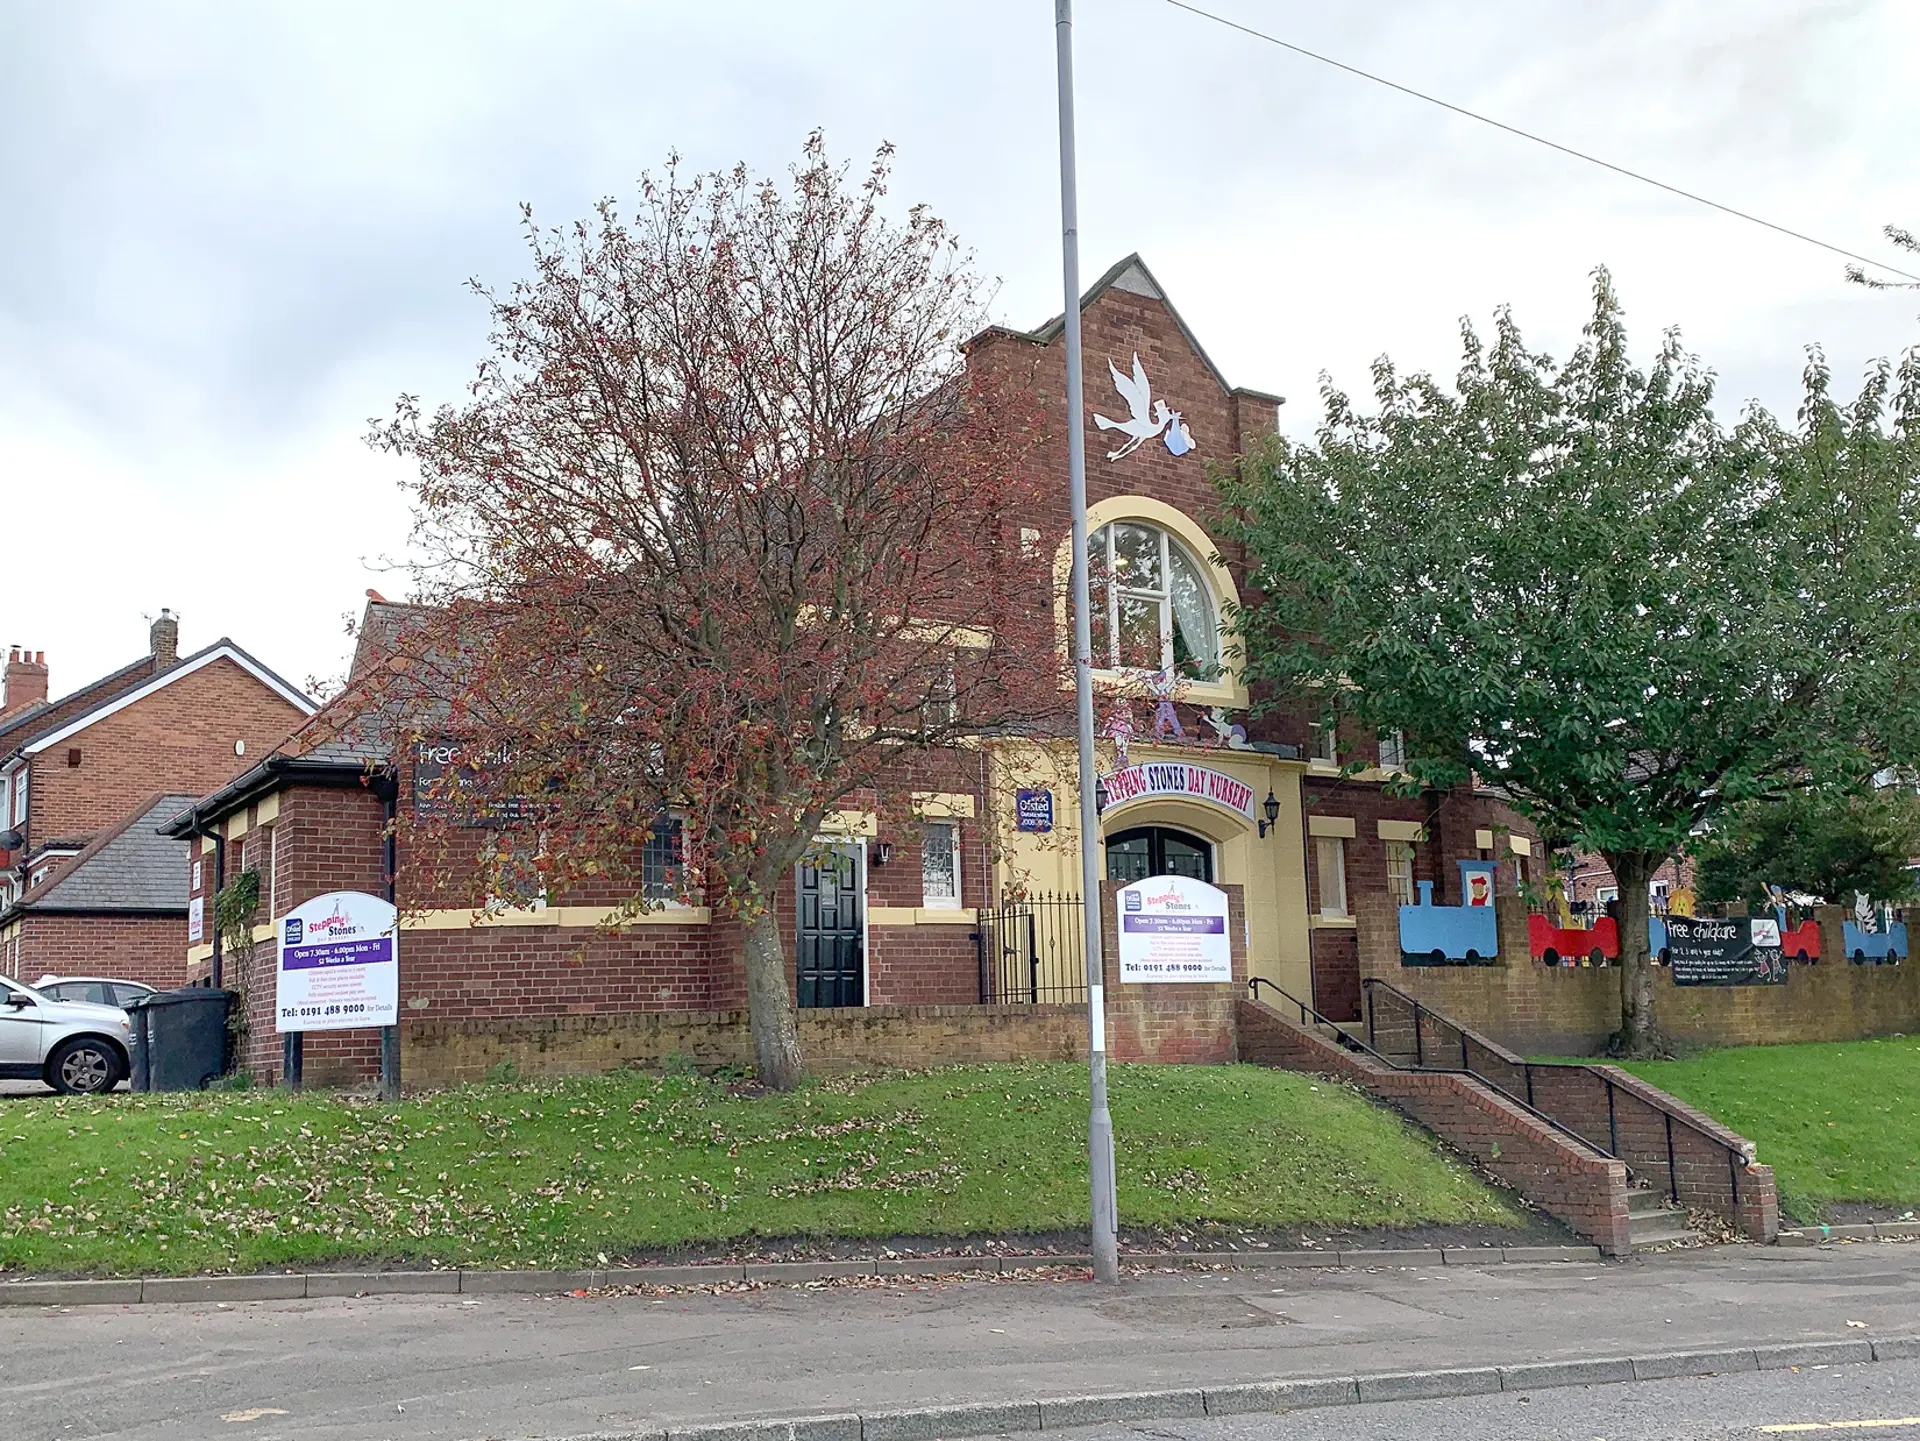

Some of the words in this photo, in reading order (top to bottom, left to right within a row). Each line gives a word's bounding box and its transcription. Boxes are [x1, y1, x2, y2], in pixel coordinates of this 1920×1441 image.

[1148, 766, 1185, 791] STONES
[1188, 767, 1206, 795] DAY
[1208, 772, 1252, 812] NURSERY
[1019, 799, 1049, 811] Ofsted
[1147, 894, 1181, 906] Stepping
[1165, 901, 1192, 910] Stones
[308, 915, 346, 933] Stepping
[1134, 916, 1149, 926] Open
[328, 924, 356, 937] Stones
[1666, 919, 1690, 938] Free
[1692, 922, 1737, 942] childcare
[293, 949, 309, 960] Open
[309, 947, 330, 957] 7.30am
[355, 944, 368, 953] Mon
[325, 956, 341, 964] Weeks
[1125, 963, 1141, 972] Tel:
[1143, 963, 1163, 973] 0191
[1165, 963, 1181, 973] 488
[1182, 964, 1203, 973] 9000
[281, 1007, 298, 1018] Tel:
[300, 1006, 321, 1017] 0191
[324, 1005, 341, 1016] 488
[343, 1003, 365, 1015] 9000
[366, 1004, 374, 1012] for
[375, 1003, 393, 1012] Details
